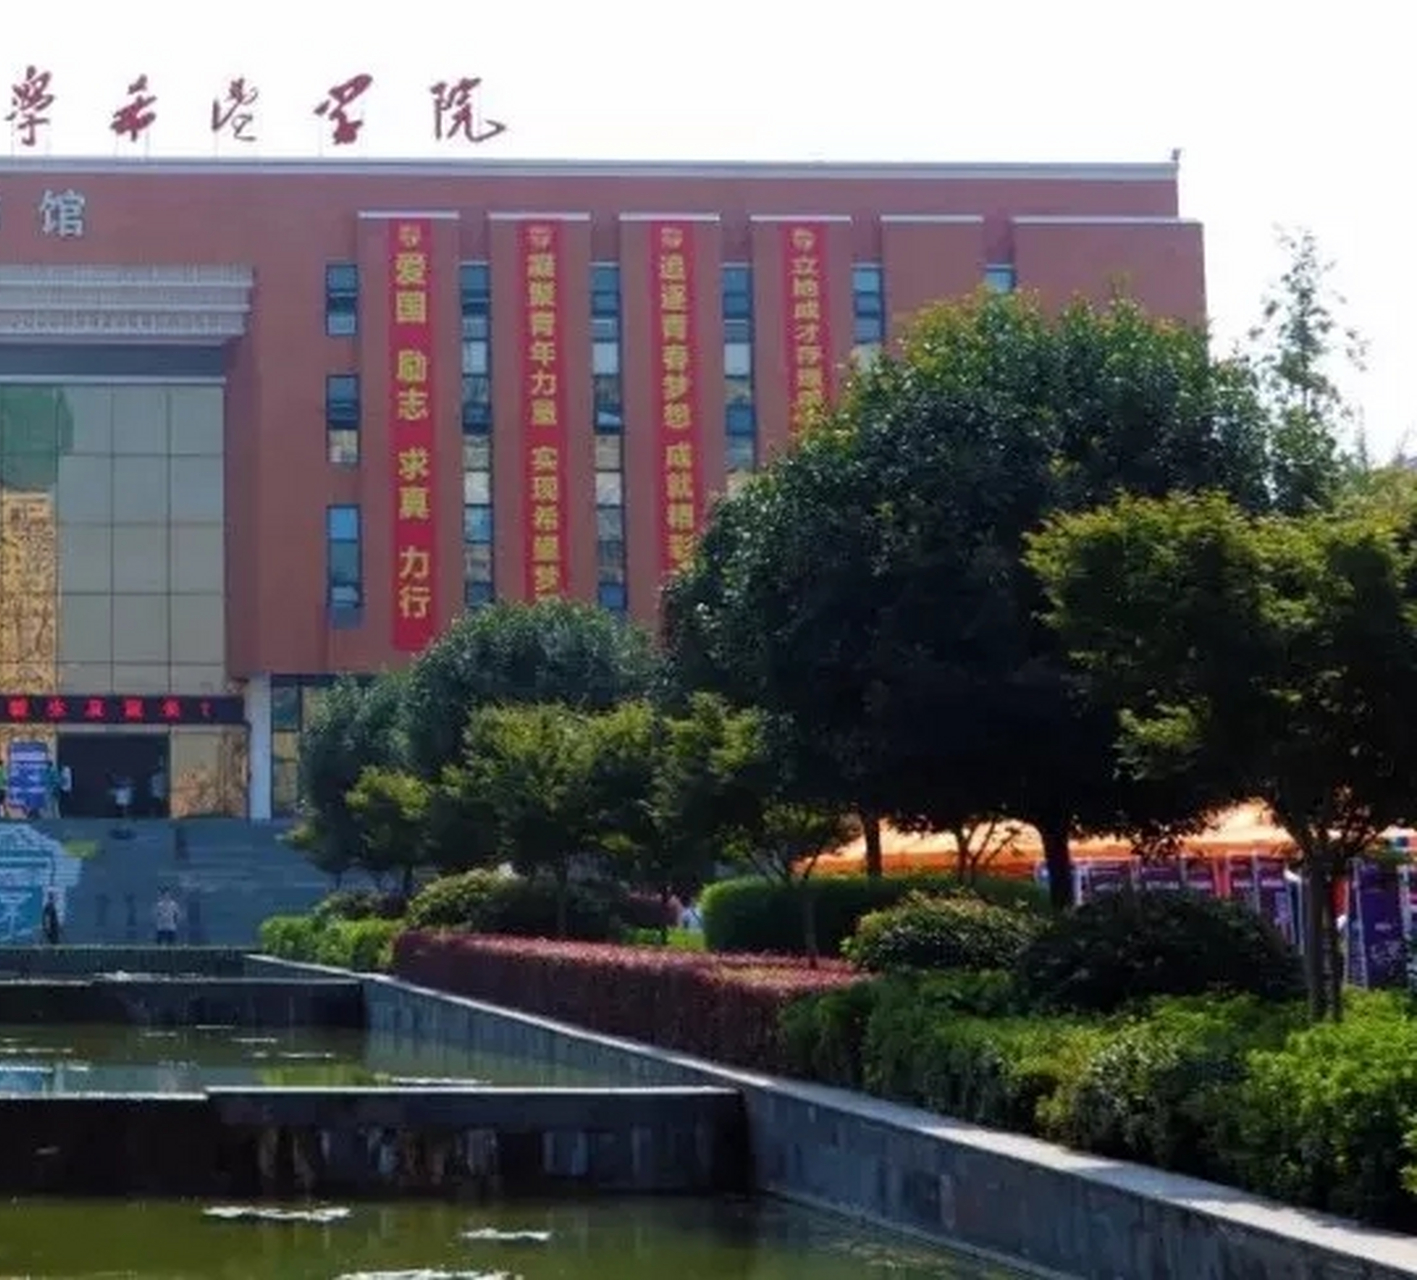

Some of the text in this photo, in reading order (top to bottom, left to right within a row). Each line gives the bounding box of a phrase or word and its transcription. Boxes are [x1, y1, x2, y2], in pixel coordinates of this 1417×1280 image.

[394, 253, 432, 620] 爱国 励志 求真 力行
[527, 253, 563, 604] 凝聚青年力量 实现希望梦
[659, 255, 692, 429] 追逐青春梦想
